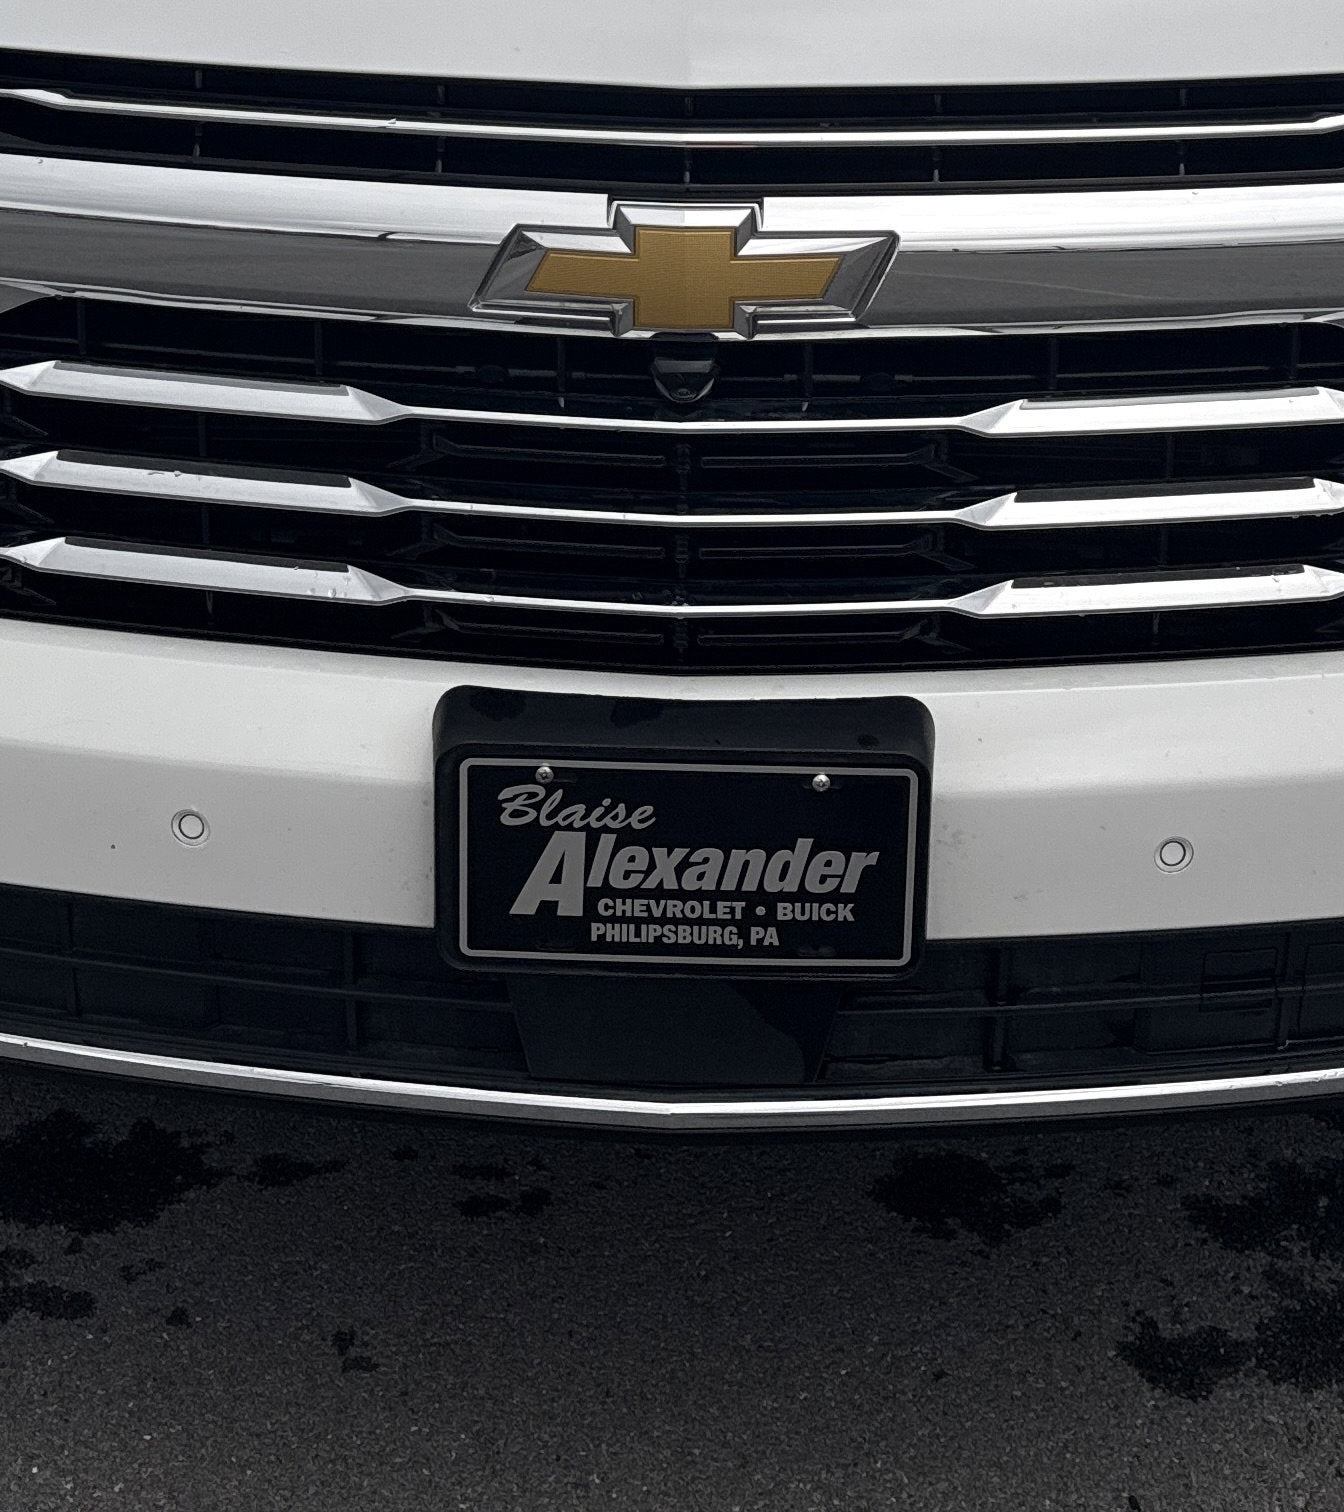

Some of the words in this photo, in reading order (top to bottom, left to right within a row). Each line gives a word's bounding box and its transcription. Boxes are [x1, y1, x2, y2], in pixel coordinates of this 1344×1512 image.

[497, 784, 656, 830] Blaise
[509, 830, 880, 917] Alexander
[597, 898, 746, 919] CHEVROLET
[776, 902, 855, 922] BUICK
[590, 922, 744, 949] PHILIPSBURG,
[750, 926, 780, 946] PA
